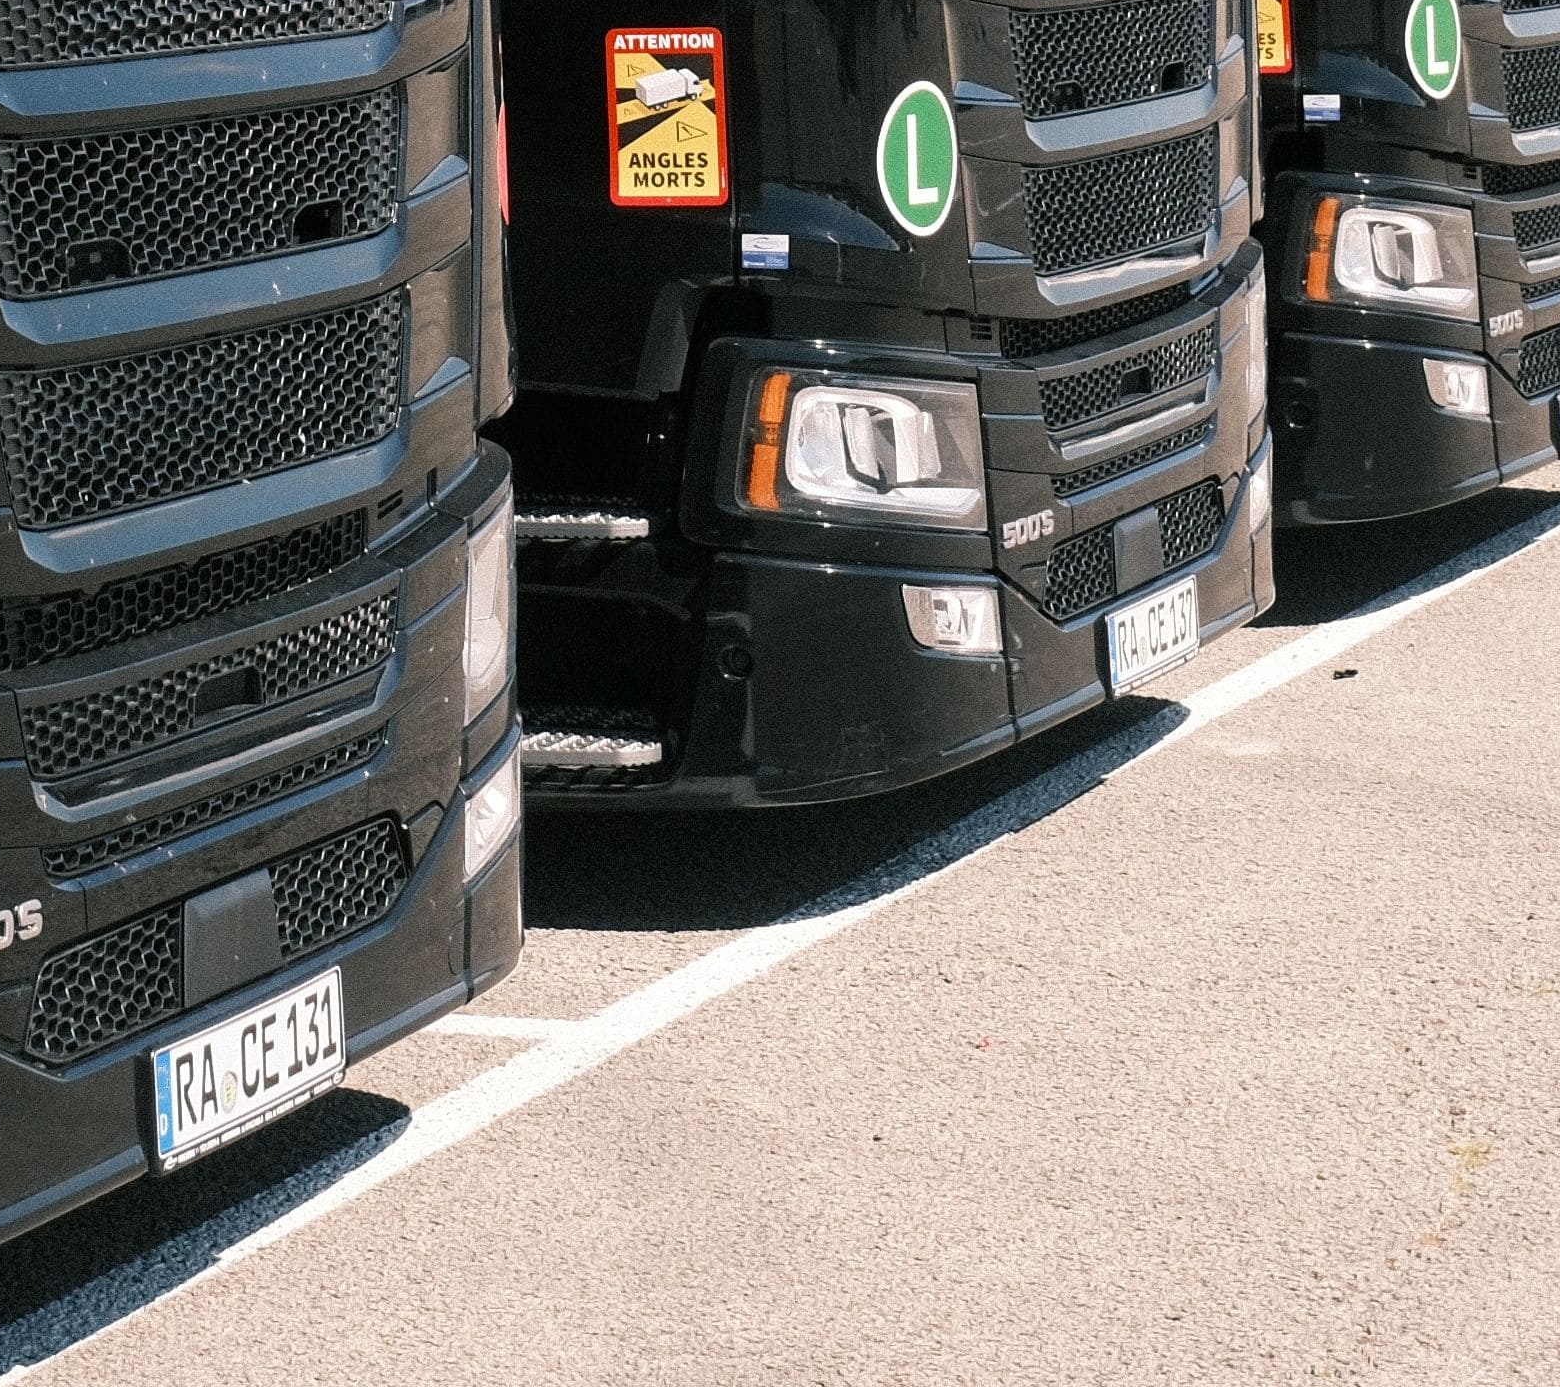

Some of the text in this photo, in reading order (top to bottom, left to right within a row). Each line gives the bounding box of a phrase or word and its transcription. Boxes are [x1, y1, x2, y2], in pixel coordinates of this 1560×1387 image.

[613, 33, 715, 50] ATTENTION
[1425, 5, 1449, 75] L
[629, 152, 709, 169] ANGLES
[633, 172, 706, 188] MORTS
[906, 113, 939, 205] L
[1118, 615, 1140, 672] RA
[1148, 601, 1168, 657] CE
[1169, 587, 1193, 647] 137
[175, 1042, 219, 1133] RA
[240, 1012, 280, 1099] CE
[286, 985, 338, 1078] 131
[159, 1113, 169, 1136] D
